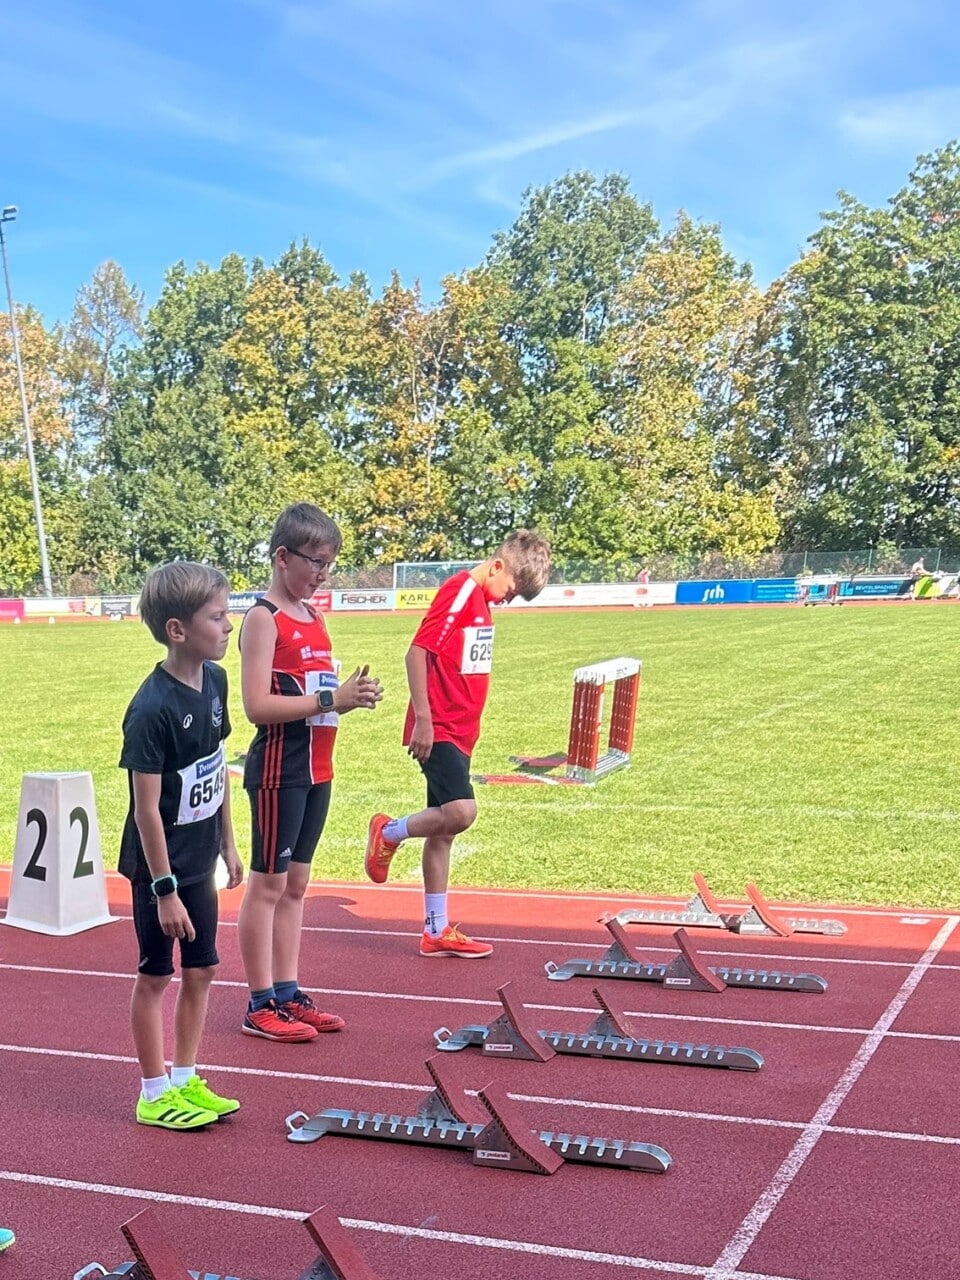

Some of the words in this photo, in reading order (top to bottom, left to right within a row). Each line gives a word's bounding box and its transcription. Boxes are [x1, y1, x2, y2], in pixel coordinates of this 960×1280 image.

[341, 593, 387, 604] FISCHER
[400, 593, 431, 601] KARL
[702, 584, 725, 602] srh
[23, 808, 47, 882] 2
[69, 806, 95, 879] 2
